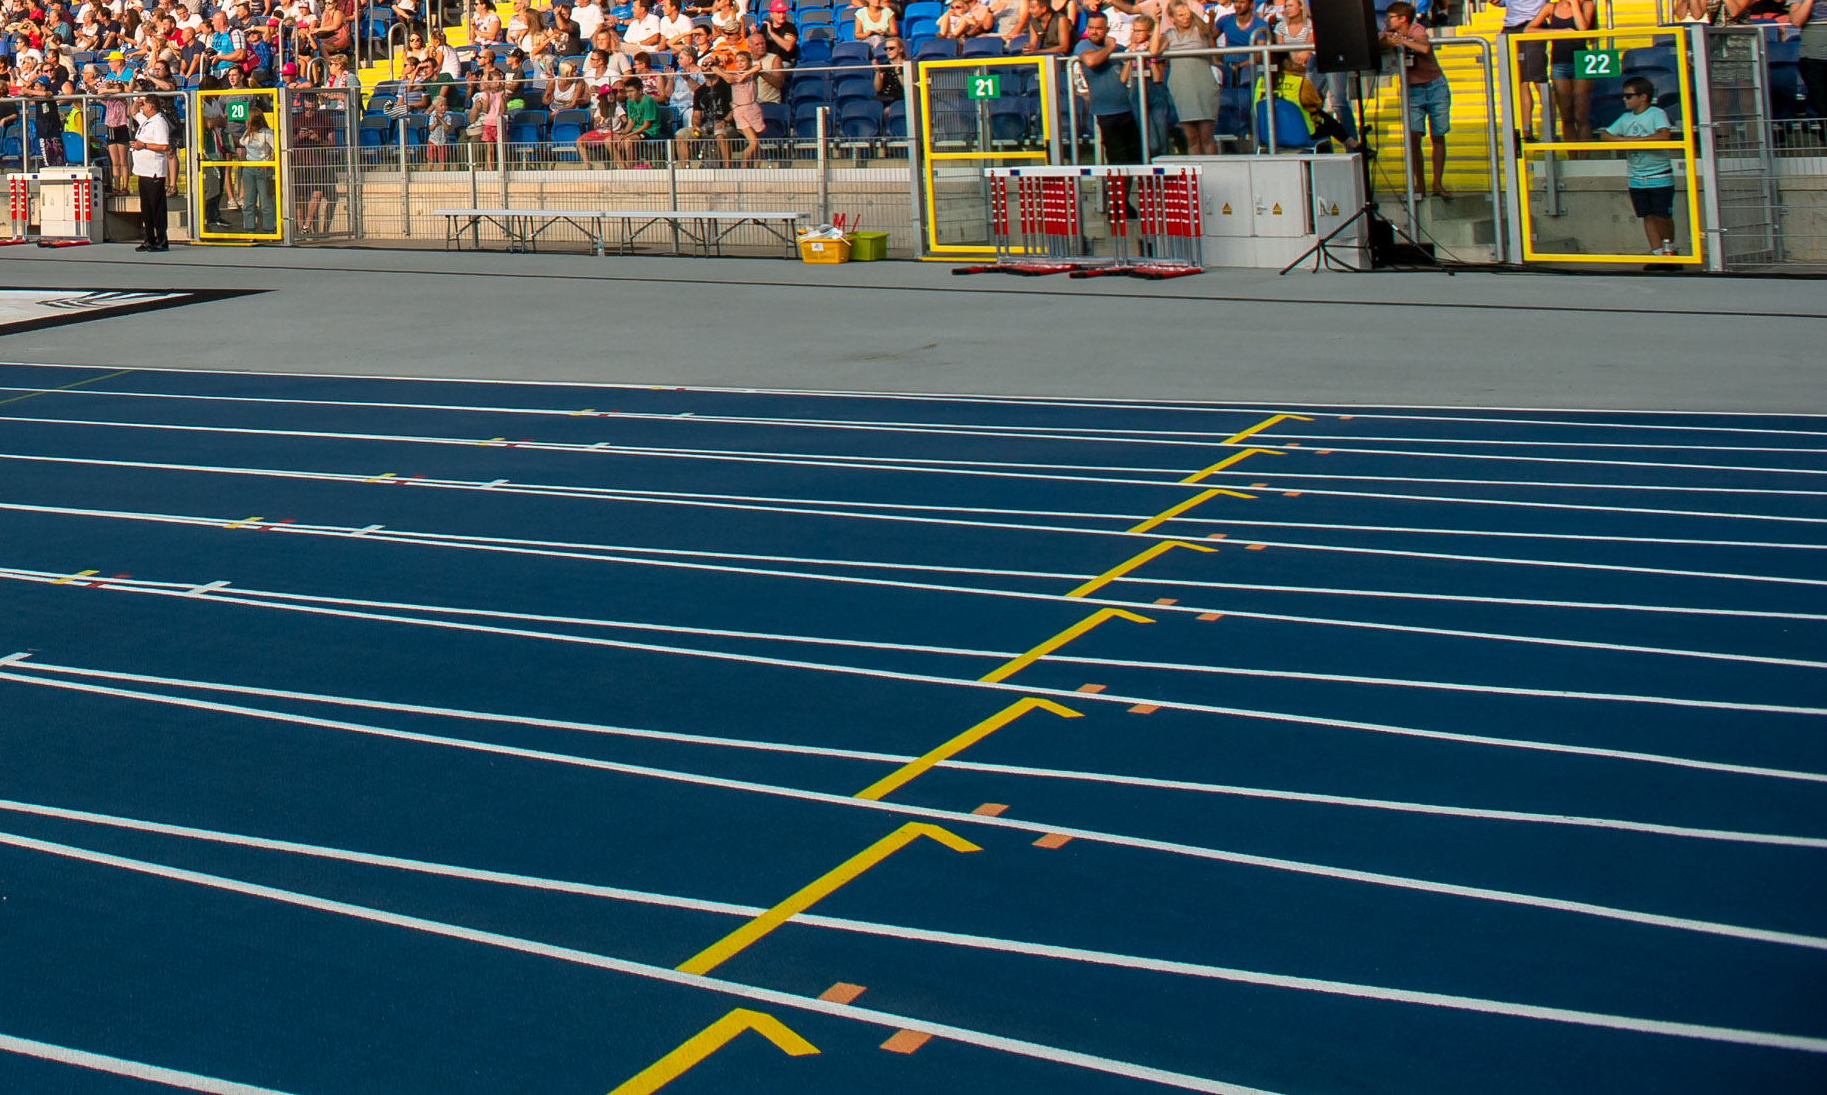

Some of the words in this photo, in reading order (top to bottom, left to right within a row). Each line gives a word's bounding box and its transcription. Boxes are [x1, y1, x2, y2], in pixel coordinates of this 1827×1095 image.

[1584, 54, 1611, 74] 22
[975, 78, 994, 96] 21
[231, 104, 245, 118] 20
